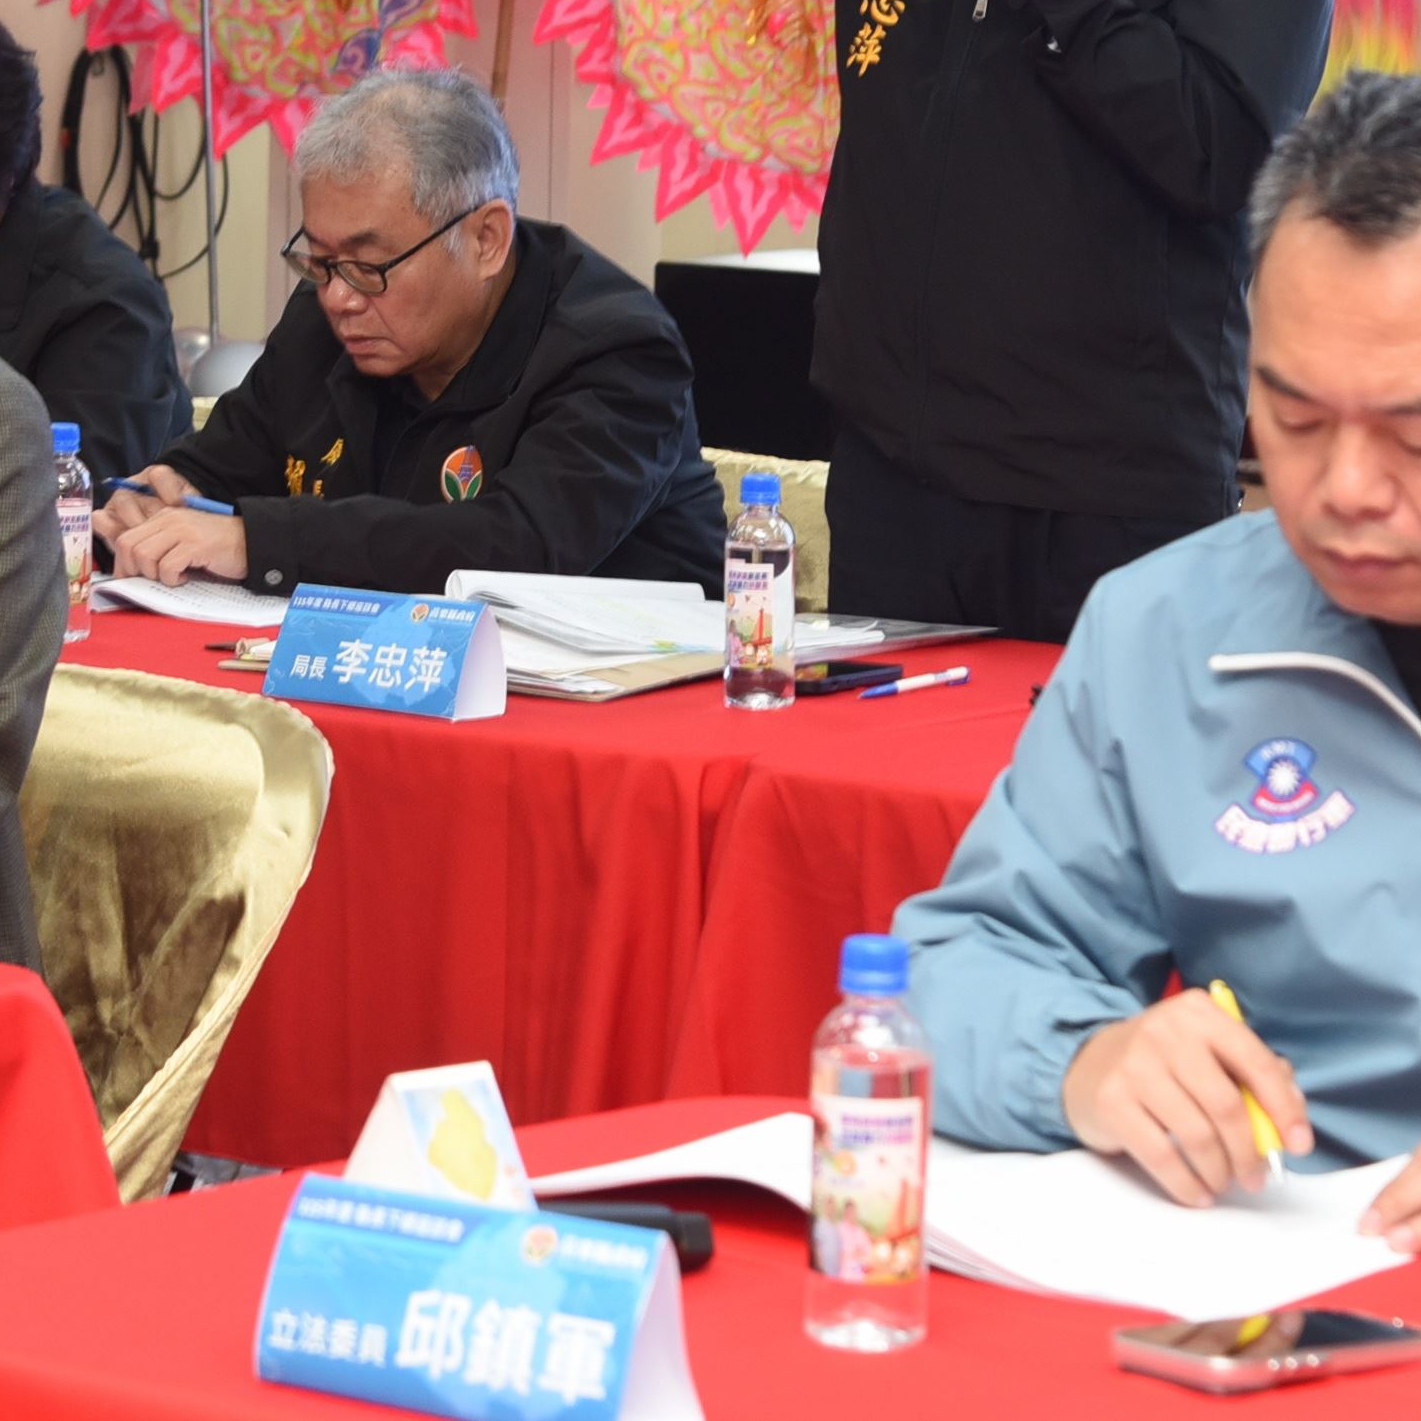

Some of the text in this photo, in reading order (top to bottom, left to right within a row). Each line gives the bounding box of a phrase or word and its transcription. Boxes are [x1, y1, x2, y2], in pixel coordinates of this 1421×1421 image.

[290, 639, 448, 693] 局長 李忠萍
